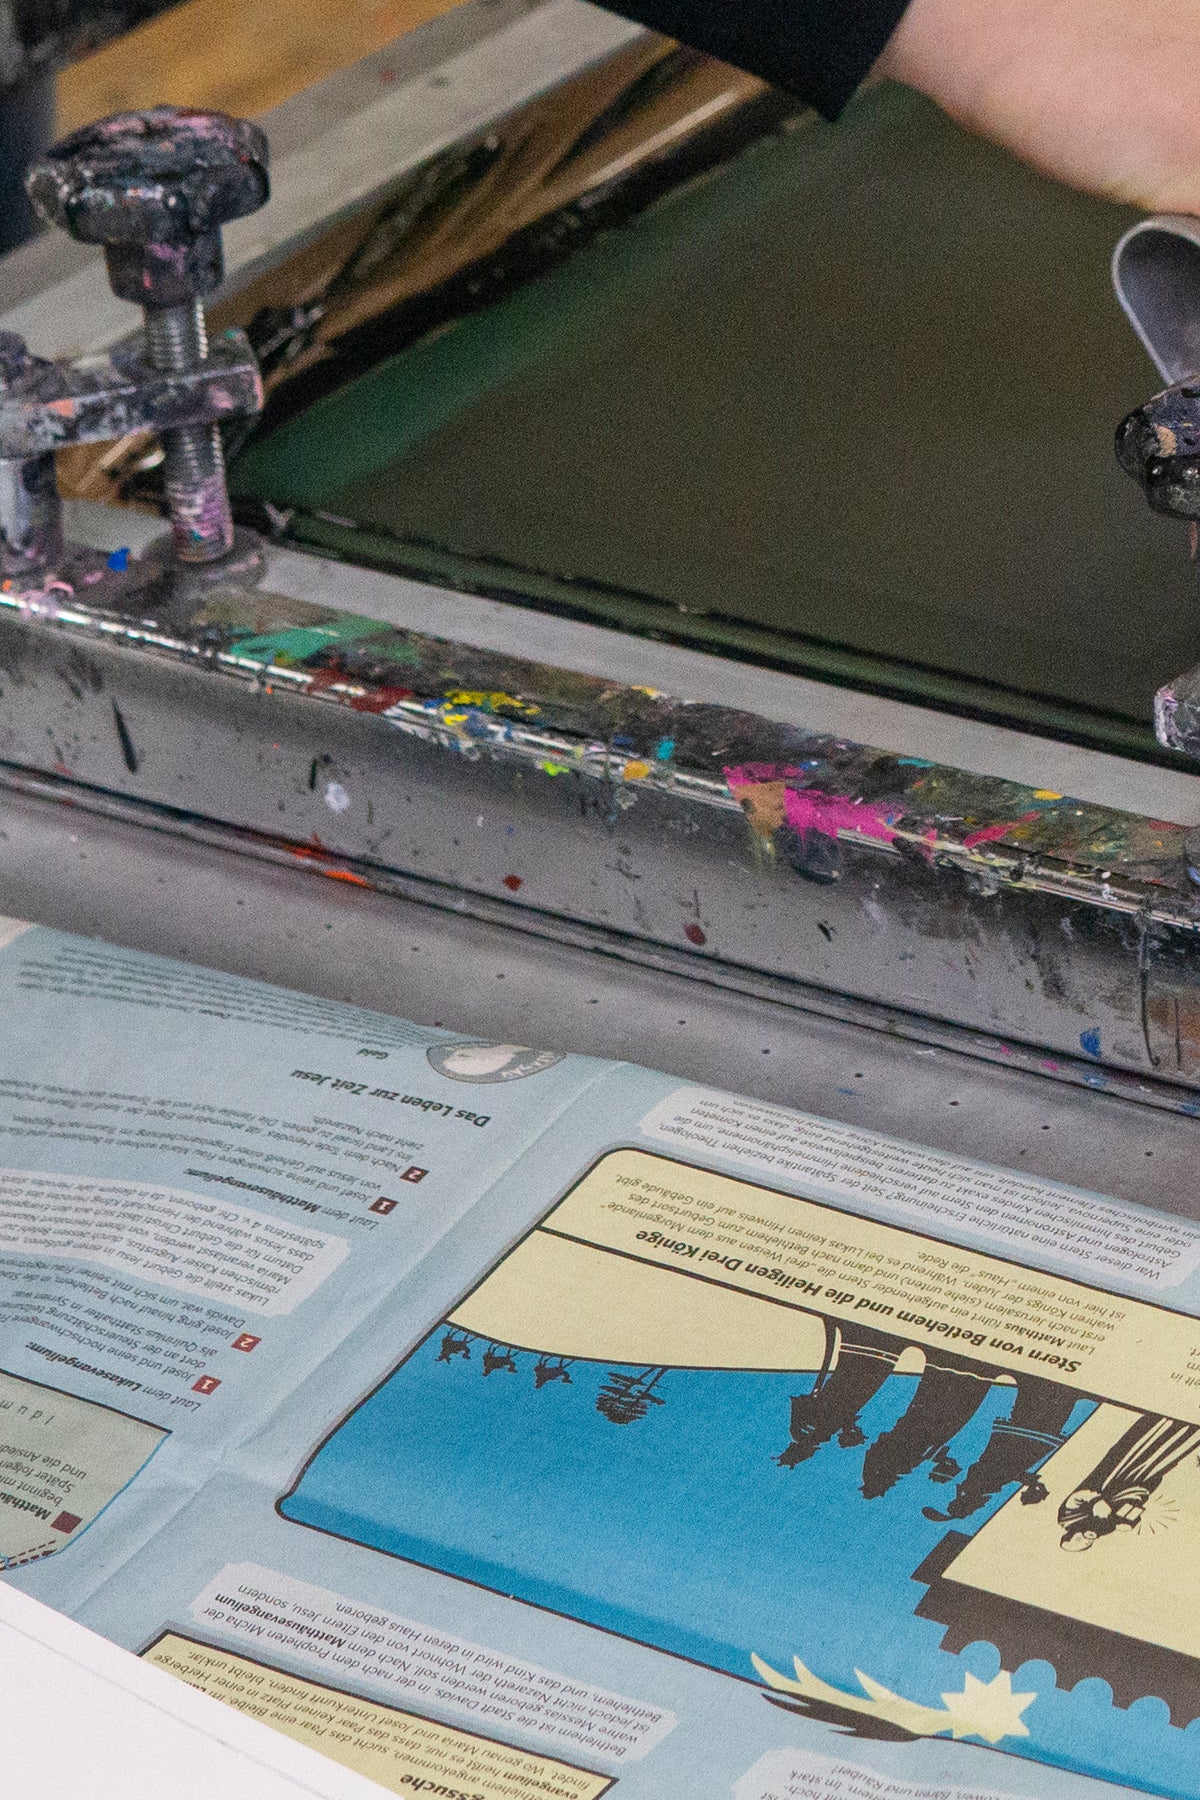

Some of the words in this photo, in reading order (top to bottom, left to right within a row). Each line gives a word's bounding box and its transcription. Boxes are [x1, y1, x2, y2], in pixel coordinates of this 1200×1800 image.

[289, 1068, 330, 1087] Jesu
[328, 1078, 367, 1096] Zeit
[368, 1087, 398, 1100] zur
[399, 1095, 453, 1117] Leben
[454, 1109, 491, 1127] Das
[721, 1141, 775, 1163] beziehen
[405, 1168, 422, 1180] 2
[776, 1158, 839, 1182] Spätantike
[840, 1177, 861, 1189] der
[859, 1183, 886, 1196] Seit
[376, 1200, 390, 1211] 1
[627, 1193, 650, 1206] des
[320, 1206, 349, 1223] dem
[650, 1200, 716, 1226] Geburtsort
[347, 1215, 378, 1231] Laut
[717, 1220, 744, 1232] zum
[968, 1215, 1029, 1238] natürliche
[686, 1225, 714, 1240] dem
[715, 1234, 738, 1245] aus
[1030, 1234, 1057, 1246] eine
[634, 1229, 700, 1258] Könige
[744, 1229, 810, 1254] Bethlehem
[114, 1251, 142, 1267] Jesu
[738, 1241, 784, 1261] Weisen
[809, 1249, 842, 1262] nach
[1058, 1243, 1092, 1259] Stern
[698, 1250, 743, 1271] Drei
[842, 1258, 874, 1274] dann
[949, 1262, 971, 1274] die
[1094, 1254, 1132, 1271] dieser
[140, 1260, 183, 1279] Geburt
[815, 1265, 837, 1278] die
[872, 1268, 900, 1280] und
[1134, 1266, 1161, 1280] War
[182, 1273, 202, 1286] die
[201, 1279, 233, 1294] stellt
[743, 1263, 822, 1296] Heiligen
[837, 1272, 871, 1288] Stern
[898, 1274, 942, 1293] unten)
[233, 1289, 269, 1307] Lukas
[823, 1287, 855, 1306] die
[871, 1282, 949, 1309] aufgehender
[942, 1289, 984, 1307] (siehe
[1016, 1282, 1056, 1298] einem
[853, 1297, 895, 1315] und
[1057, 1294, 1082, 1306] von
[949, 1306, 970, 1316] ein
[983, 1301, 1047, 1326] Jerusalem
[1082, 1302, 1107, 1316] hier
[1107, 1310, 1126, 1321] ist
[895, 1309, 987, 1346] Betlehem
[969, 1312, 1002, 1328] führt
[1046, 1320, 1079, 1333] nach
[1003, 1322, 1066, 1346] Matthäus
[1079, 1330, 1106, 1341] erst
[238, 1337, 254, 1348] 2
[988, 1337, 1025, 1354] von
[1065, 1340, 1095, 1354] Laut
[1026, 1349, 1081, 1373] Stern
[199, 1379, 214, 1390] 1
[1169, 1371, 1184, 1382] in
[141, 1385, 172, 1403] dem
[169, 1396, 201, 1412] Laut
[40, 1456, 60, 1470] die
[59, 1463, 87, 1478] und
[33, 1470, 75, 1493] Später
[14, 1482, 63, 1506] beginnt
[214, 1593, 346, 1647] Matthäusevangelium
[387, 1621, 422, 1639] Haus
[347, 1642, 377, 1658] dem
[423, 1634, 460, 1654] deren
[375, 1652, 412, 1670] Nach
[461, 1648, 474, 1659] in
[473, 1653, 505, 1668] wird
[227, 1666, 265, 1684] bleibt
[504, 1664, 536, 1681] Kind
[440, 1674, 488, 1694] werden
[537, 1676, 561, 1690] das
[560, 1684, 588, 1697] und
[309, 1694, 378, 1722] Unterkunft
[489, 1691, 544, 1711] geboren
[377, 1716, 412, 1733] Josef
[543, 1708, 596, 1731] Messias
[412, 1728, 440, 1740] und
[597, 1726, 638, 1743] wahre
[440, 1736, 480, 1755] Maria
[480, 1750, 523, 1766] genau
[522, 1762, 546, 1775] Wo
